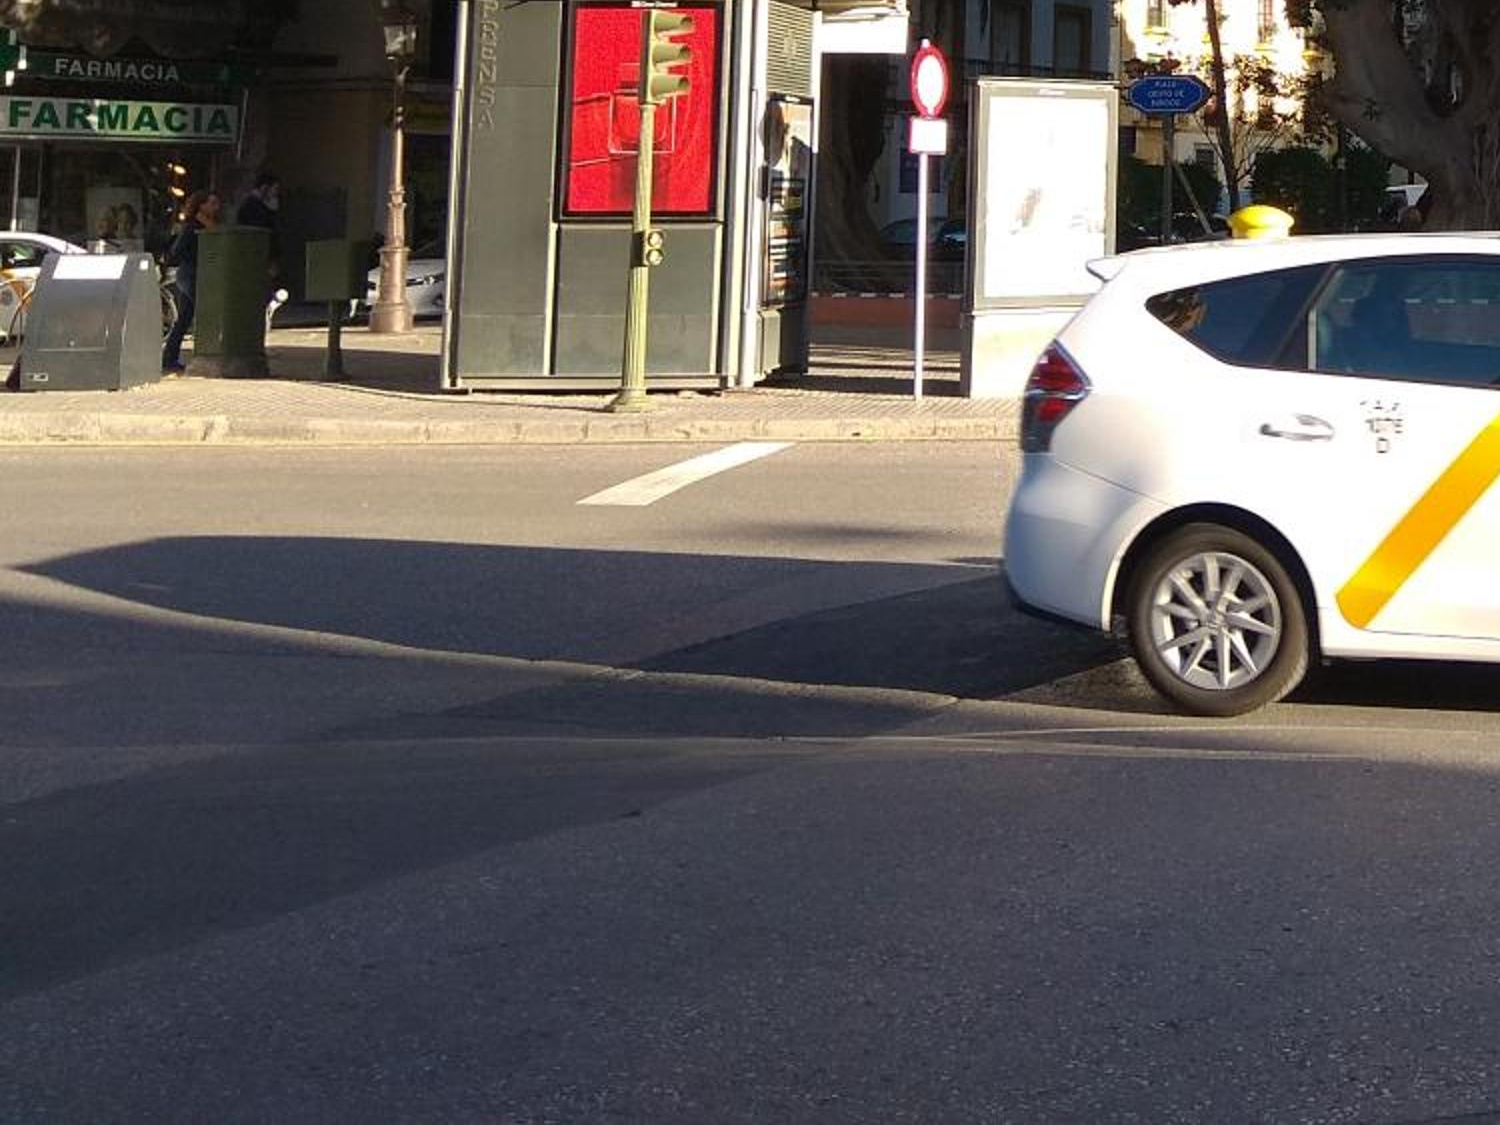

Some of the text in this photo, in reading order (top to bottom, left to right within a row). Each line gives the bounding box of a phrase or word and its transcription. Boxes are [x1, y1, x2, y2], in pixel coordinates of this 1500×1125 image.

[54, 57, 180, 81] FARMACIA
[478, 0, 499, 130] PRENSA
[8, 99, 232, 134] FARMACIA
